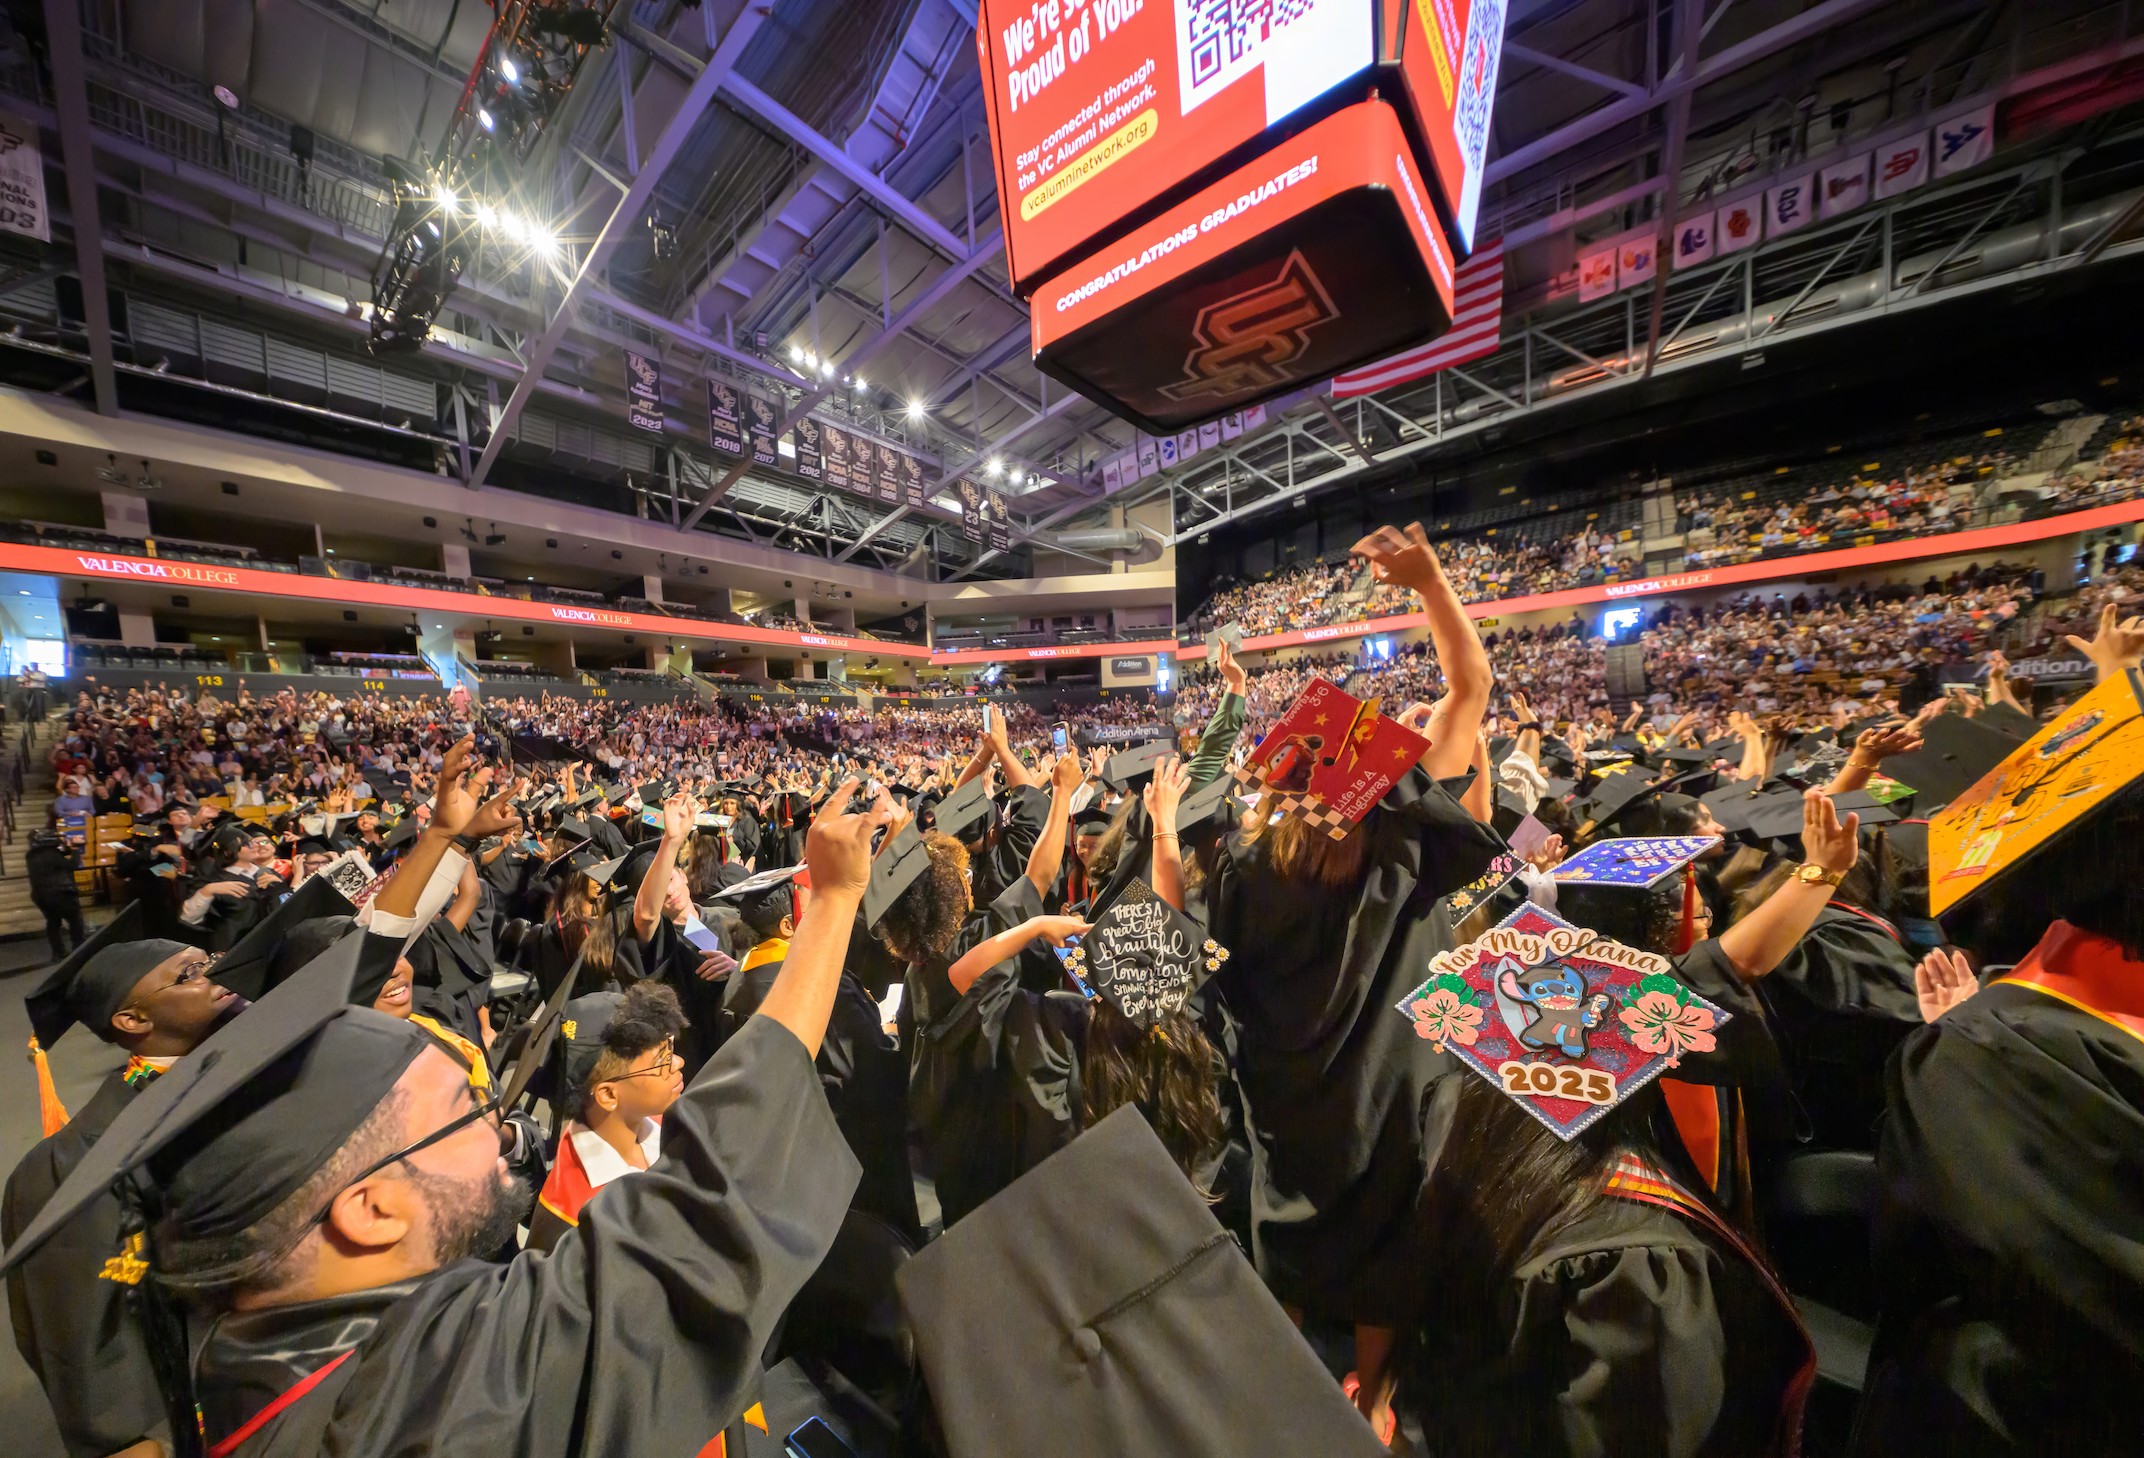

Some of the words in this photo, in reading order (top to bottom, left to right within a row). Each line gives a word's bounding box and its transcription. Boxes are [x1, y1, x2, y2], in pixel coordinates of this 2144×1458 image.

[1003, 0, 1060, 68] We're
[1008, 31, 1066, 113] Proud
[1068, 8, 1090, 63] of
[1016, 145, 1040, 171] Stay
[1041, 95, 1101, 152] connected
[1103, 58, 1155, 106] through
[1017, 169, 1037, 191] the
[1036, 154, 1054, 176] VC
[1056, 123, 1097, 164] Alumni
[1098, 83, 1157, 133] Network.
[1028, 120, 1148, 211] vcalumninetwork.org
[1056, 224, 1197, 312] CONGRATULATIONS
[1200, 155, 1319, 233] GRADUATES!
[633, 414, 662, 430] 2023
[714, 436, 740, 453] 2019
[754, 452, 775, 464] 2017
[799, 465, 820, 478] 2012
[852, 481, 871, 494] 2004
[965, 509, 979, 526] 23
[196, 675, 223, 686] 113
[363, 680, 385, 691] 114
[1309, 686, 1329, 707] 3:6
[1281, 694, 1310, 727] Proverbs
[1331, 788, 1357, 812] Life
[1352, 778, 1367, 795] Is
[1364, 769, 1378, 781] A
[1343, 773, 1391, 819] Highway
[1110, 899, 1152, 923] THERE'S
[1153, 901, 1163, 917] A
[1102, 919, 1144, 947] great
[1141, 910, 1170, 934] big
[1093, 929, 1193, 966] beautiful
[1482, 931, 1543, 962] My
[1550, 930, 1662, 972] Ohana
[1096, 953, 1200, 987] tomorrow
[1113, 982, 1145, 996] SHINING
[1158, 977, 1180, 989] END
[1181, 973, 1193, 983] OF
[1503, 1065, 1612, 1101] 2025
